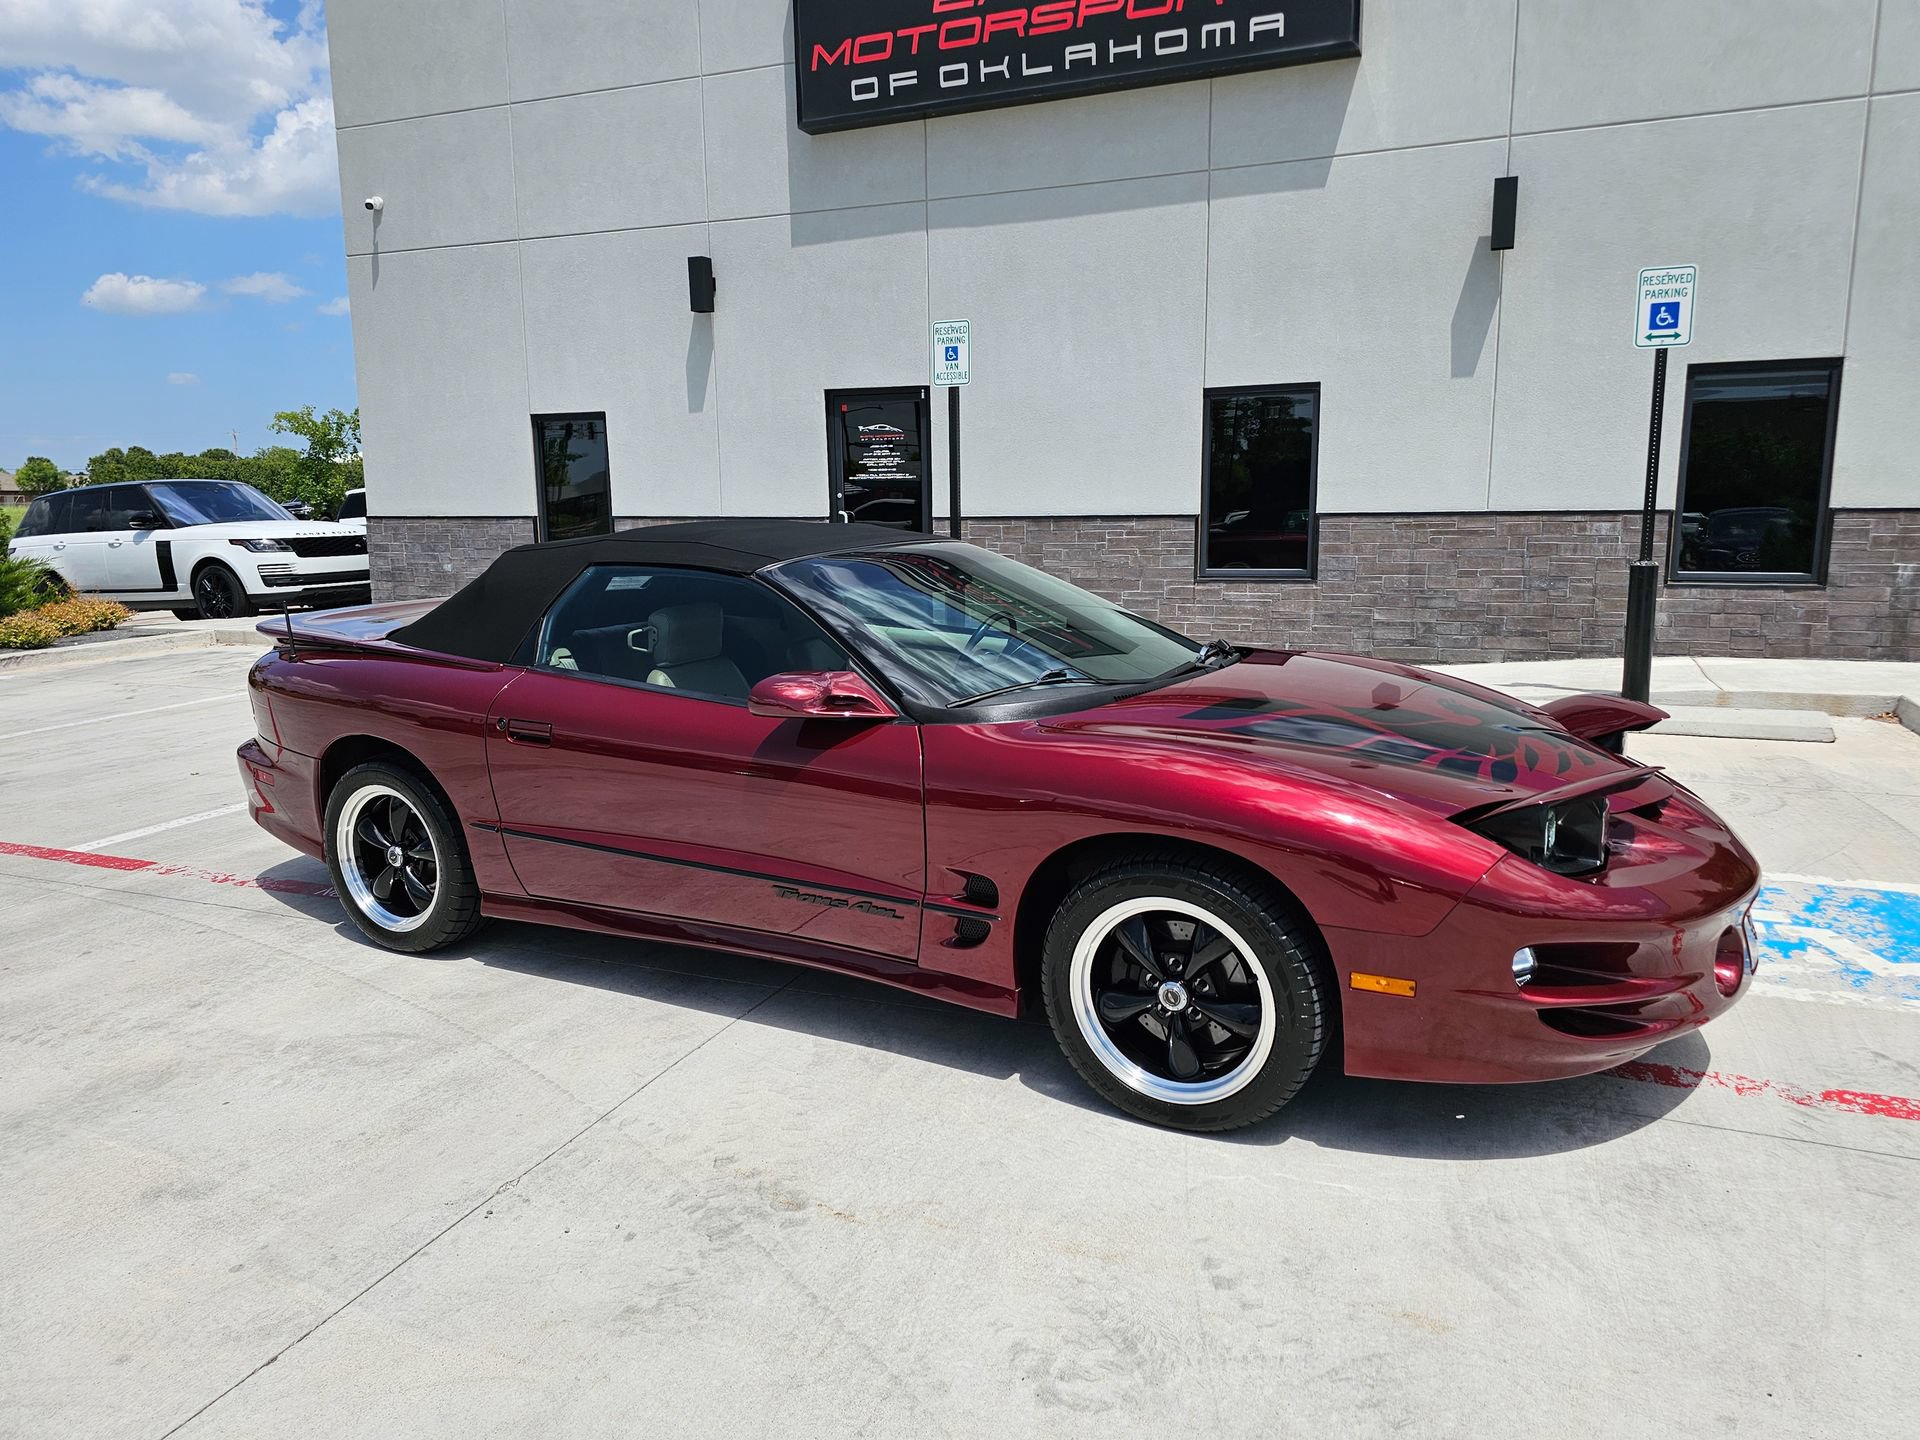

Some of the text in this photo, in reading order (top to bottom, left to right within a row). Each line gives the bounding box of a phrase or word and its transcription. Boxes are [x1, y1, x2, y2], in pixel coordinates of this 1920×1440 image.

[850, 12, 1286, 102] OF OKLAHOMA
[1642, 273, 1693, 287] RESERVED
[1644, 287, 1688, 299] PARKING
[935, 325, 968, 336] RESERVED
[937, 336, 966, 345] PARKING
[945, 362, 959, 370] VAN
[936, 371, 968, 381] ACCESSIBLE
